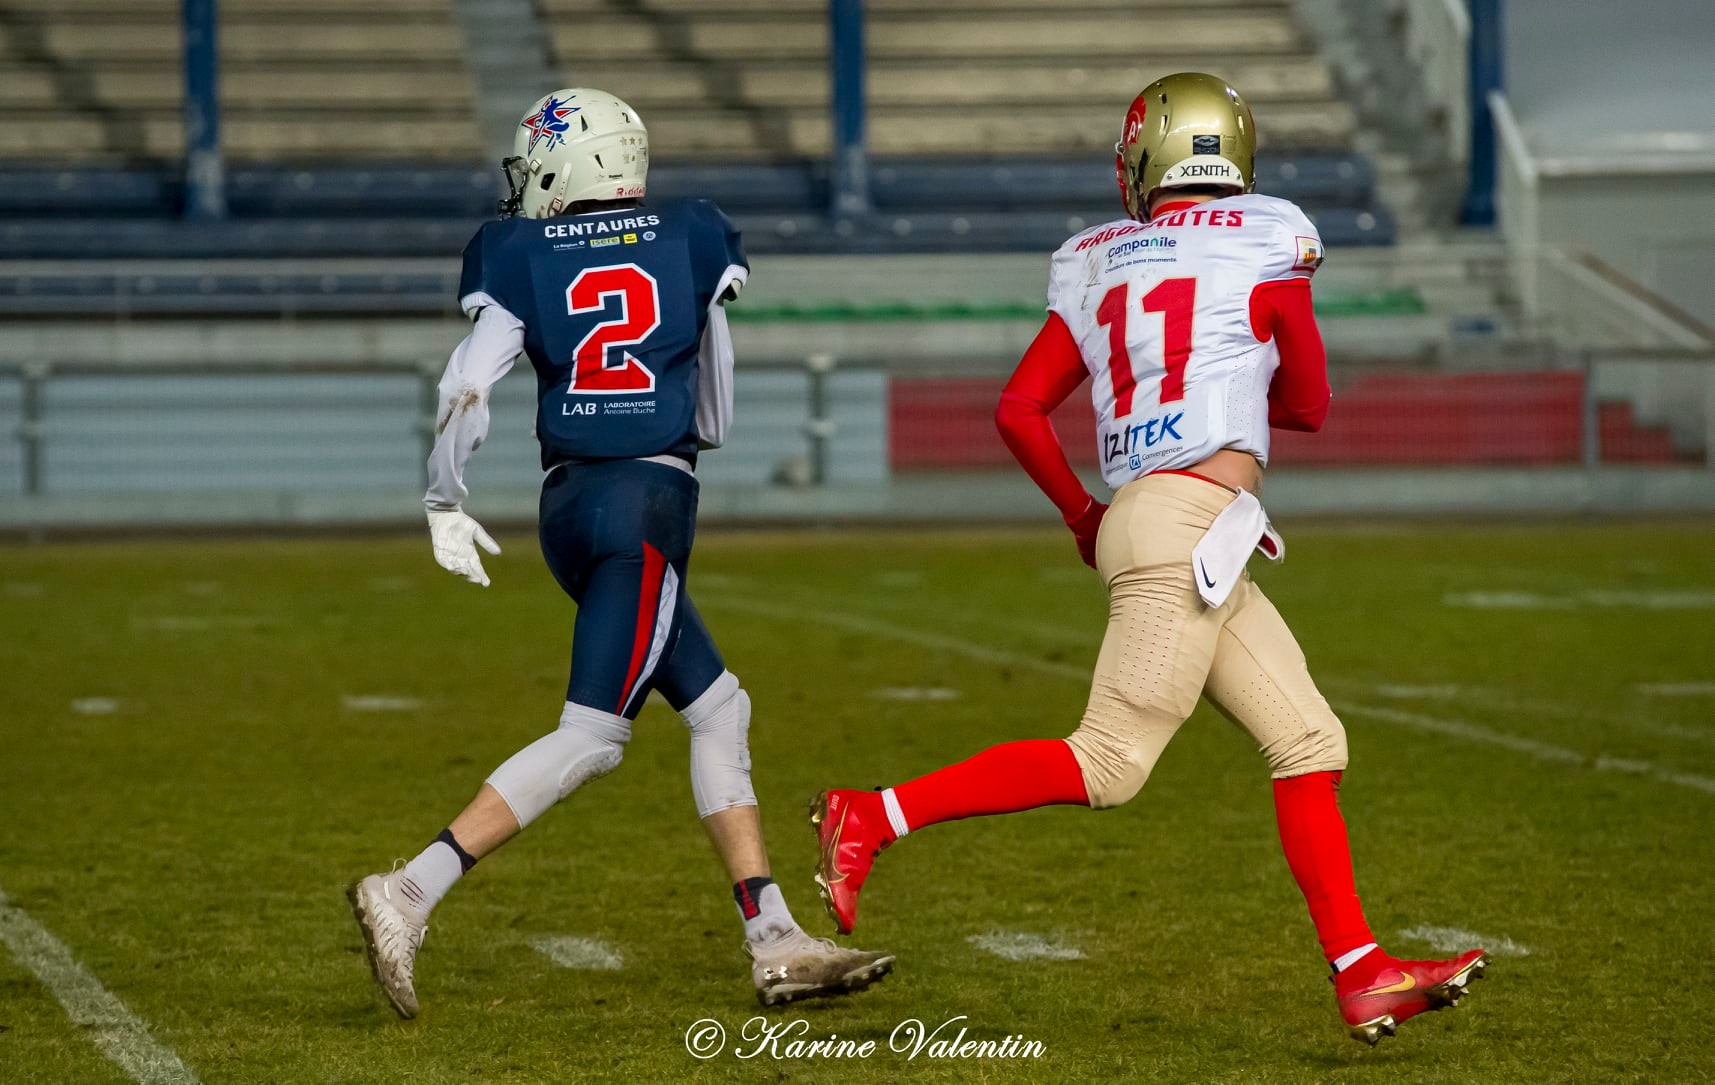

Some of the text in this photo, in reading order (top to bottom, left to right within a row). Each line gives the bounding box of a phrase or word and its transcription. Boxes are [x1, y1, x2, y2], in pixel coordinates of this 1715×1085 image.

[1181, 165, 1230, 177] XENITH
[544, 215, 660, 238] CENTAURES
[1075, 210, 1243, 252] ARGOUTES
[1108, 237, 1177, 257] Campanile
[566, 263, 661, 395] 2
[1096, 277, 1196, 419] 11
[562, 403, 597, 415] LAB
[604, 401, 656, 409] LABORATOIRE
[1142, 446, 1183, 461] Convergences
